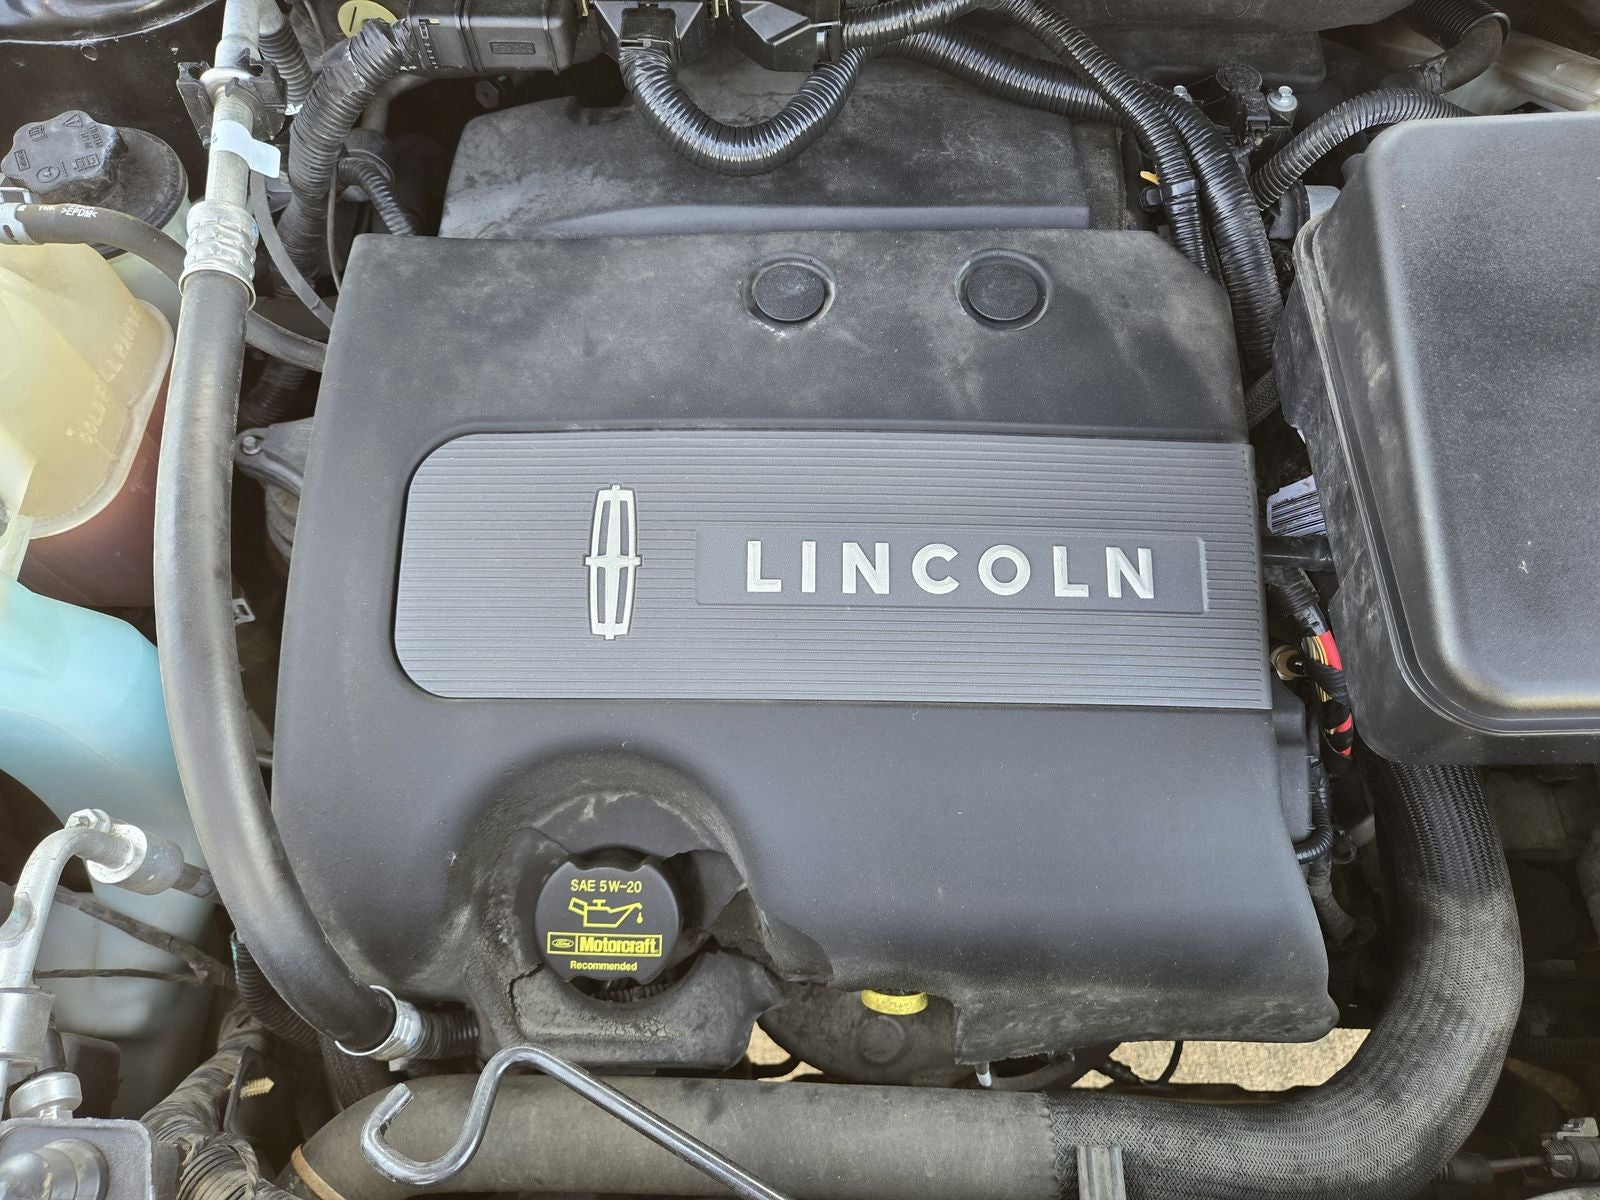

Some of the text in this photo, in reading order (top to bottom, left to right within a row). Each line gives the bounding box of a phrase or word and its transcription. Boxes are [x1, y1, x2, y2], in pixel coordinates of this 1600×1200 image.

[746, 540, 1154, 599] LINCOLN
[570, 879, 642, 893] SAE 5W-20
[580, 936, 657, 954] Motorcraft
[570, 960, 638, 972] Recommended
